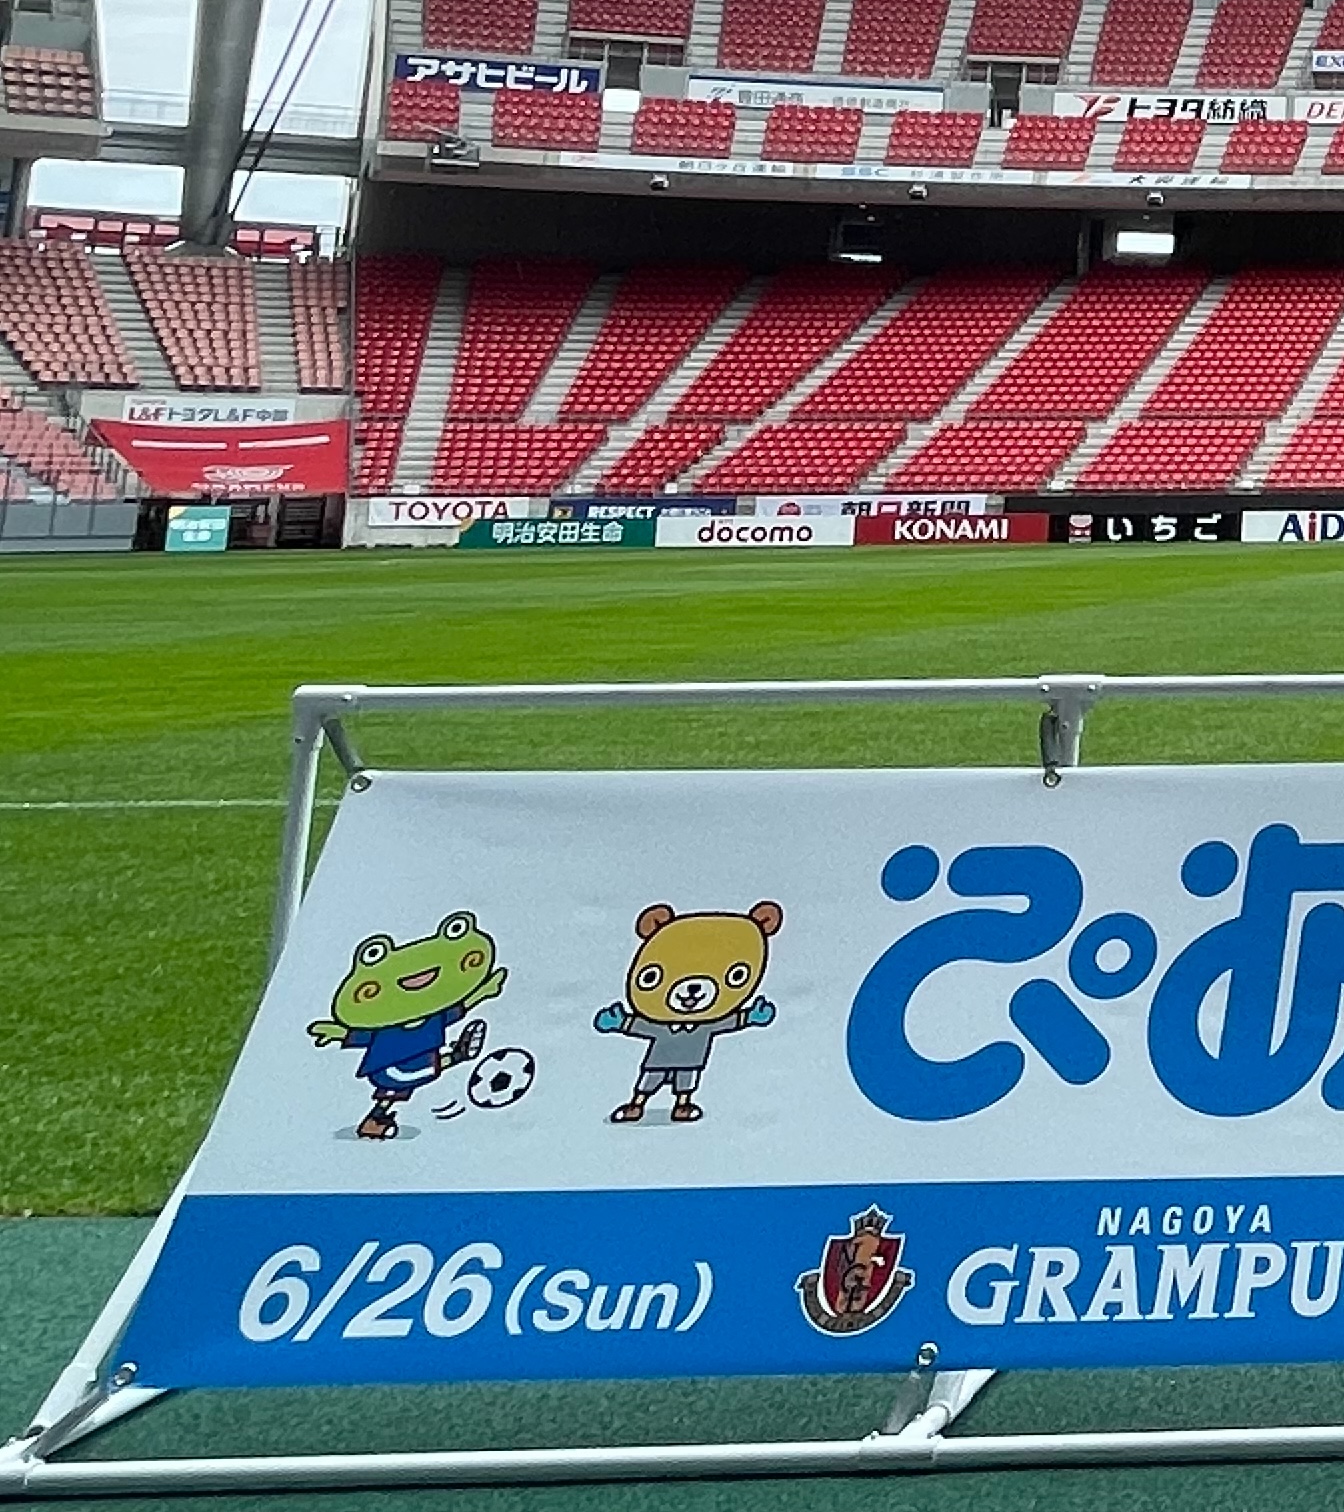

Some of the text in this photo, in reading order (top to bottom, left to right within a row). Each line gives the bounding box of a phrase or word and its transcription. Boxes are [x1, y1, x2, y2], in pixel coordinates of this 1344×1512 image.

[405, 58, 588, 94] アサヒビール
[389, 501, 510, 520] TOYOTA
[492, 522, 624, 544] 明治安田生命
[697, 520, 814, 543] docomo
[894, 517, 1009, 541] KONAMI
[1106, 513, 1222, 542] いちご
[1097, 1205, 1273, 1236] NAGOYA
